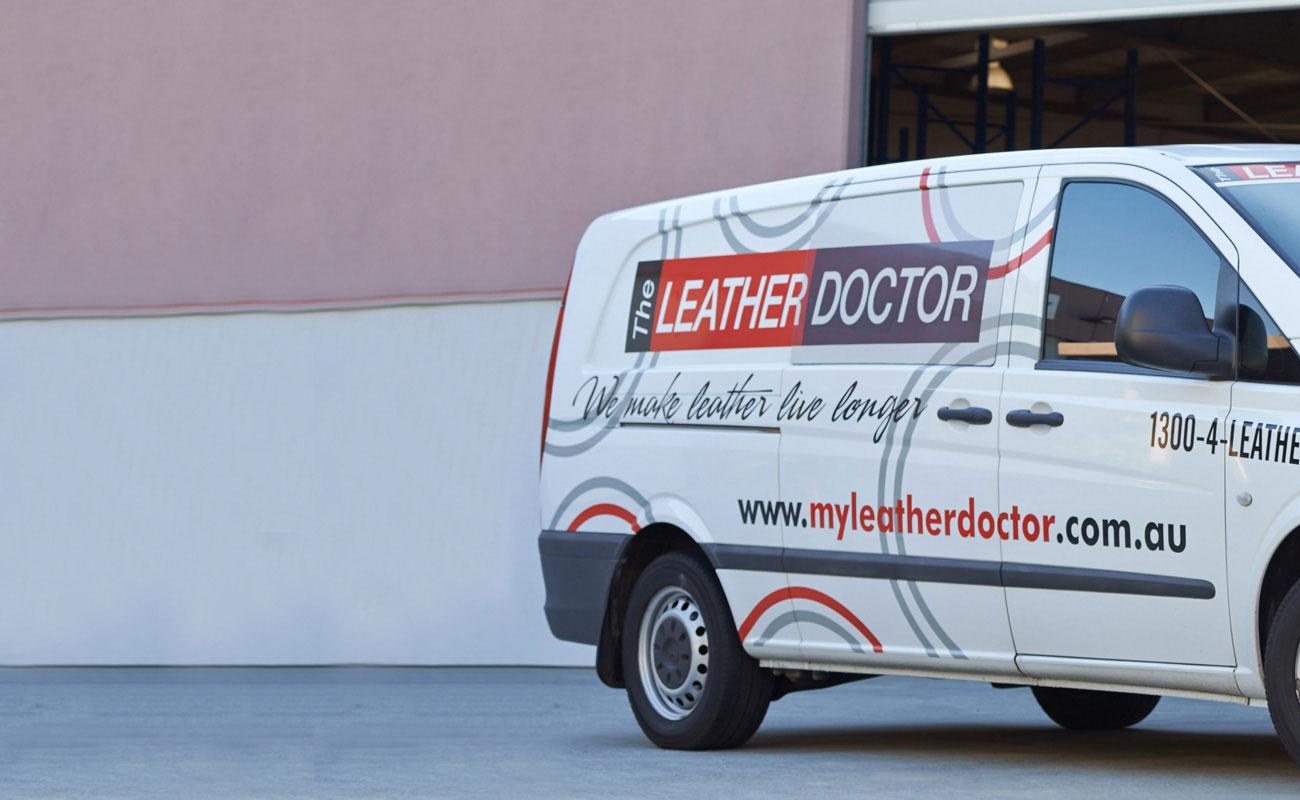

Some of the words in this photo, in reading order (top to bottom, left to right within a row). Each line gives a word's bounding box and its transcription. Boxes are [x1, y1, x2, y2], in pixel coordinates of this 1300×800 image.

[632, 278, 656, 341] The
[655, 272, 809, 334] LEATHER
[810, 265, 978, 326] DOCTOR
[573, 375, 619, 421] We
[623, 371, 684, 425] make
[686, 373, 773, 421] leather
[776, 380, 826, 421] live
[830, 380, 928, 444] longer
[738, 492, 1187, 553] www.myleatherdoctor.com.au
